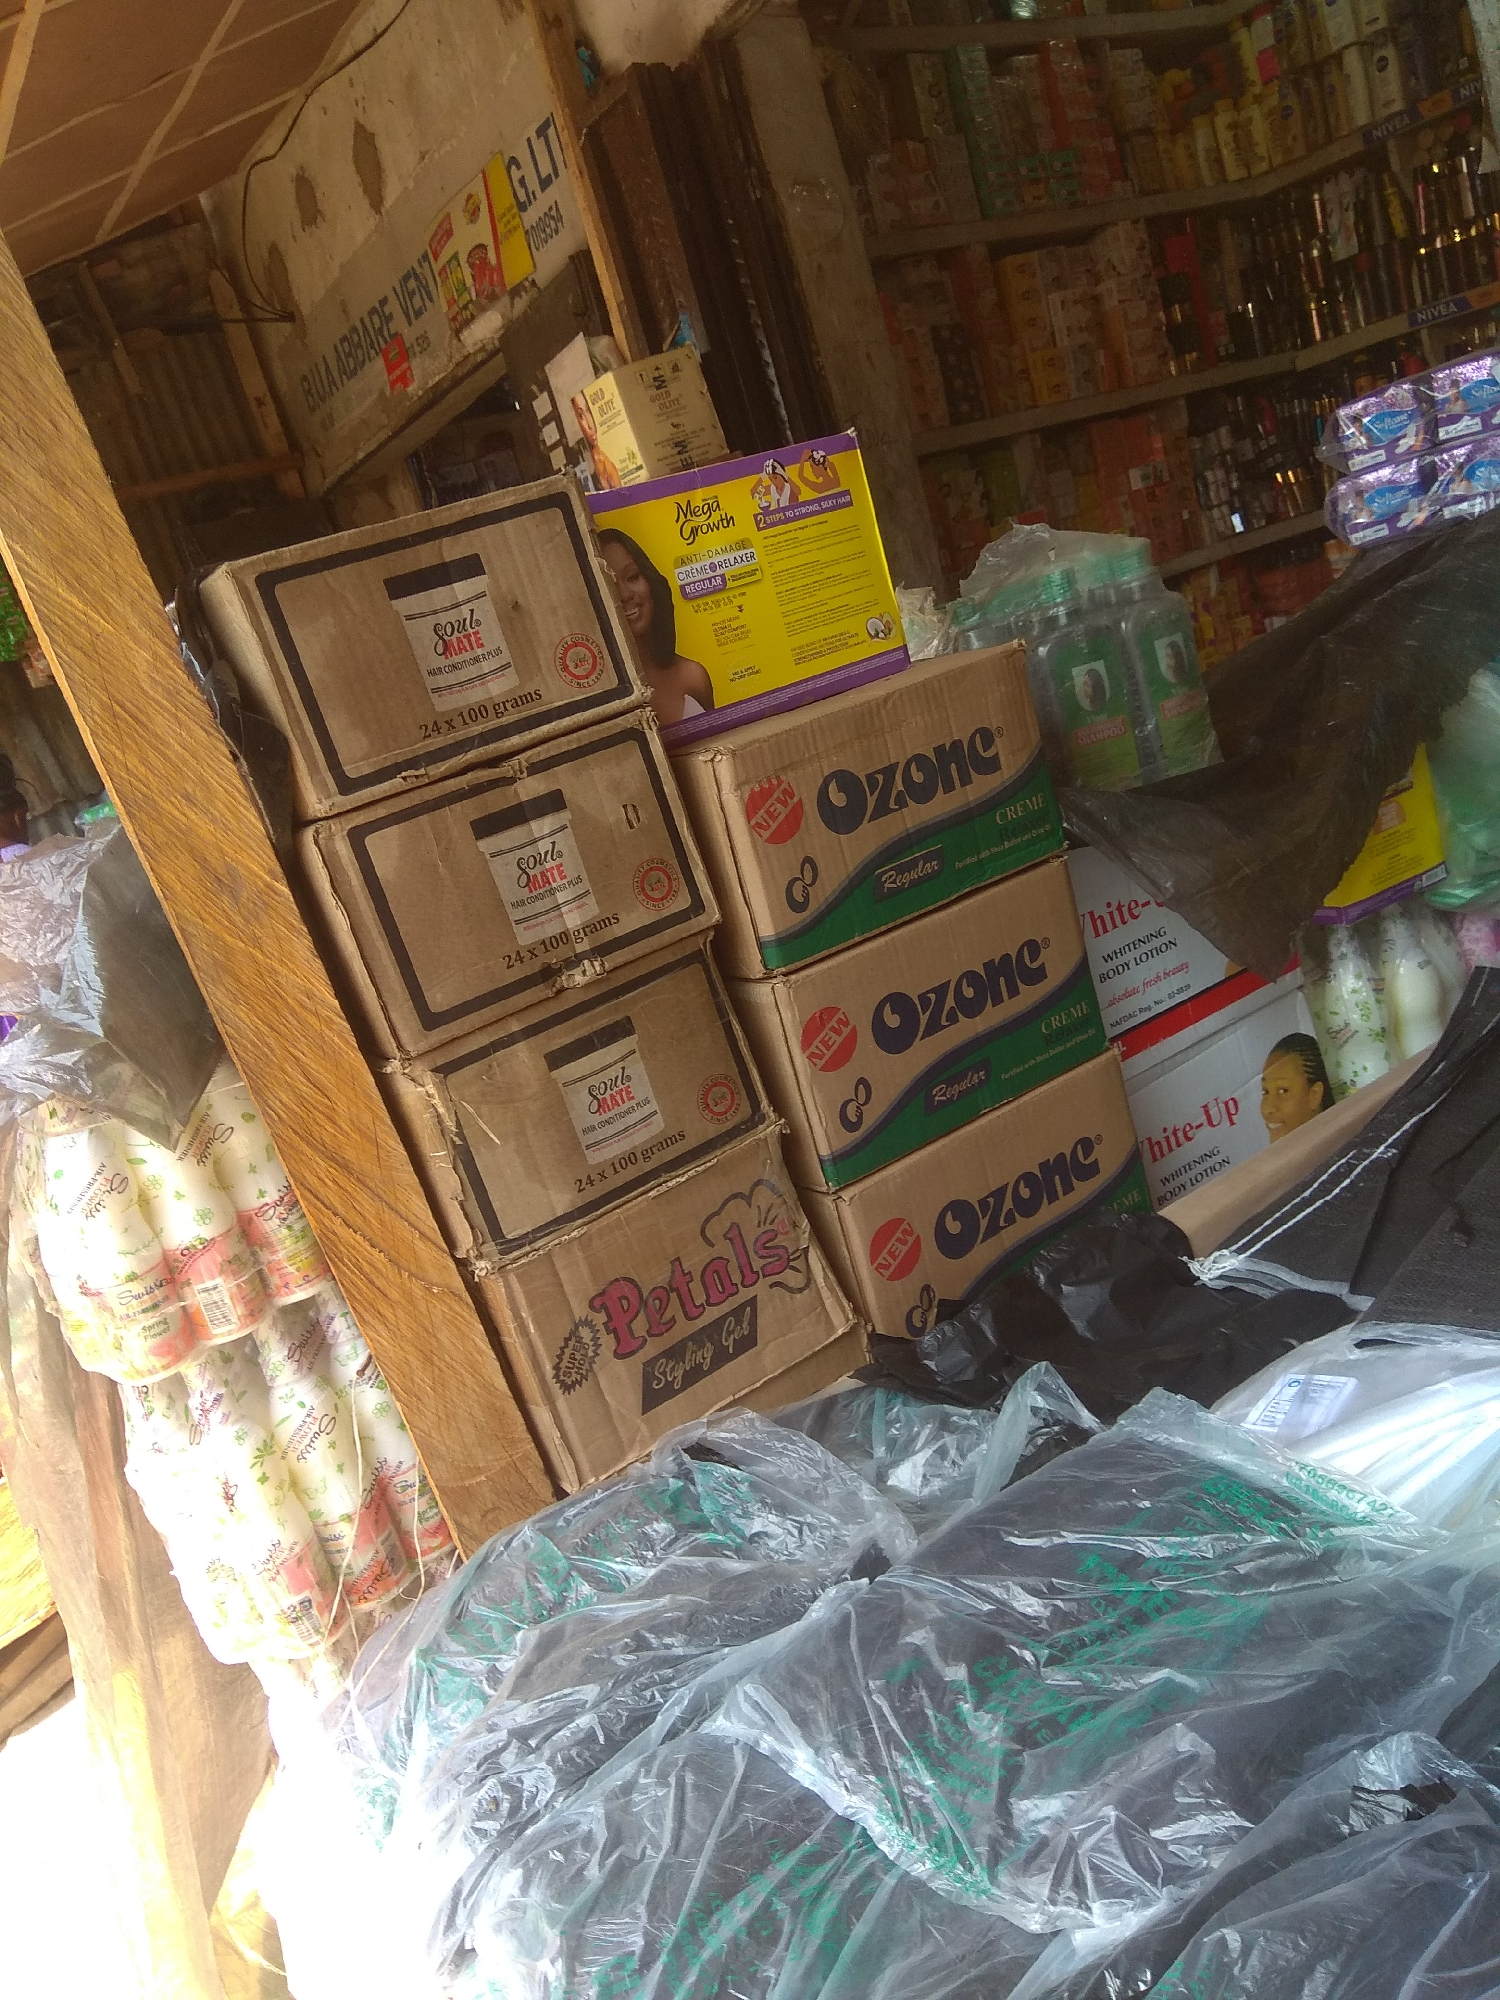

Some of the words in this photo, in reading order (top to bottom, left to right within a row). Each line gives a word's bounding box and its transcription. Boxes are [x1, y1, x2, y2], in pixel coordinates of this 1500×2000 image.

[526, 112, 568, 193] LT
[1417, 302, 1458, 322] NIVEA
[589, 387, 606, 406] GOLD
[598, 398, 616, 418] OLIVE
[650, 389, 671, 403] GOLD
[674, 499, 721, 523] Mega
[680, 512, 736, 546] Growth
[757, 514, 767, 528] 2
[765, 512, 785, 524] STEPS
[785, 510, 795, 518] TO
[821, 498, 837, 509] SILKY
[837, 494, 851, 505] HAIR
[677, 563, 710, 582] CRÈME
[717, 551, 757, 570] RELAXER
[680, 540, 748, 566] ANTI-DAMAGE
[685, 575, 723, 594] REGULAR
[433, 608, 476, 657] Soul
[442, 629, 485, 661] MATE
[426, 666, 445, 677] HAIR
[444, 653, 487, 674] CONDITIONER
[486, 646, 503, 661] PLUS
[559, 640, 569, 673] QUALITY
[570, 635, 604, 661] COSMETICS
[569, 678, 591, 688] SINCE
[420, 720, 442, 740] 24
[444, 718, 457, 731] x
[458, 704, 489, 726] 100
[493, 689, 543, 719] grams
[816, 726, 1003, 835] Ozone
[752, 778, 797, 841] NEW
[996, 792, 1047, 825] CREME
[516, 841, 557, 889] Soul
[527, 862, 568, 893] MATE
[634, 866, 645, 896] QUALITY
[646, 859, 678, 881] COSMETICS
[881, 855, 940, 893] Regular
[510, 898, 527, 910] HAIR
[526, 882, 568, 905] CONDITIONER
[567, 874, 583, 891] PLUS
[645, 900, 665, 909] SINCE
[1079, 899, 1165, 939] hite-
[502, 950, 525, 970] 24
[526, 947, 539, 960] x
[540, 931, 569, 954] 100
[573, 912, 621, 945] grams
[1102, 926, 1168, 964] WHITENING
[1099, 959, 1132, 984] BODY
[1134, 938, 1179, 967] LOTION
[1142, 974, 1162, 996] fresh
[1163, 960, 1190, 979] beauty
[871, 938, 1049, 1055] Ozone
[1041, 1000, 1091, 1034] CREME
[1110, 1010, 1139, 1029] NAFDAC
[1138, 1003, 1154, 1016] Reg.
[806, 1011, 851, 1072] NEW
[587, 1066, 627, 1115] Soul
[931, 1067, 987, 1106] Regular
[1001, 1064, 1024, 1080] Fortified
[596, 1084, 635, 1117] MATE
[699, 1082, 710, 1112] QUALITY
[581, 1124, 597, 1136] HAIR
[597, 1105, 636, 1130] CONDITIONER
[635, 1096, 651, 1112] PLUS
[197, 1122, 234, 1167] Swiss
[574, 1174, 595, 1194] 24
[597, 1169, 609, 1182] x
[609, 1151, 638, 1176] 100
[640, 1130, 686, 1163] grams
[1157, 1182, 1187, 1207] BODY
[1189, 1155, 1232, 1187] LOTION
[1159, 1145, 1221, 1187] WHITENING
[934, 1136, 1101, 1261] Ozone
[873, 1221, 916, 1277] NEW
[588, 1221, 790, 1361] Petals
[141, 1317, 170, 1334] Spring
[143, 1325, 172, 1342] Flower
[562, 1336, 585, 1379] SUPER
[574, 1341, 591, 1376] HOLD
[652, 1336, 714, 1389] Styling
[721, 1306, 751, 1354] Gel
[296, 1413, 337, 1464] Swiss
